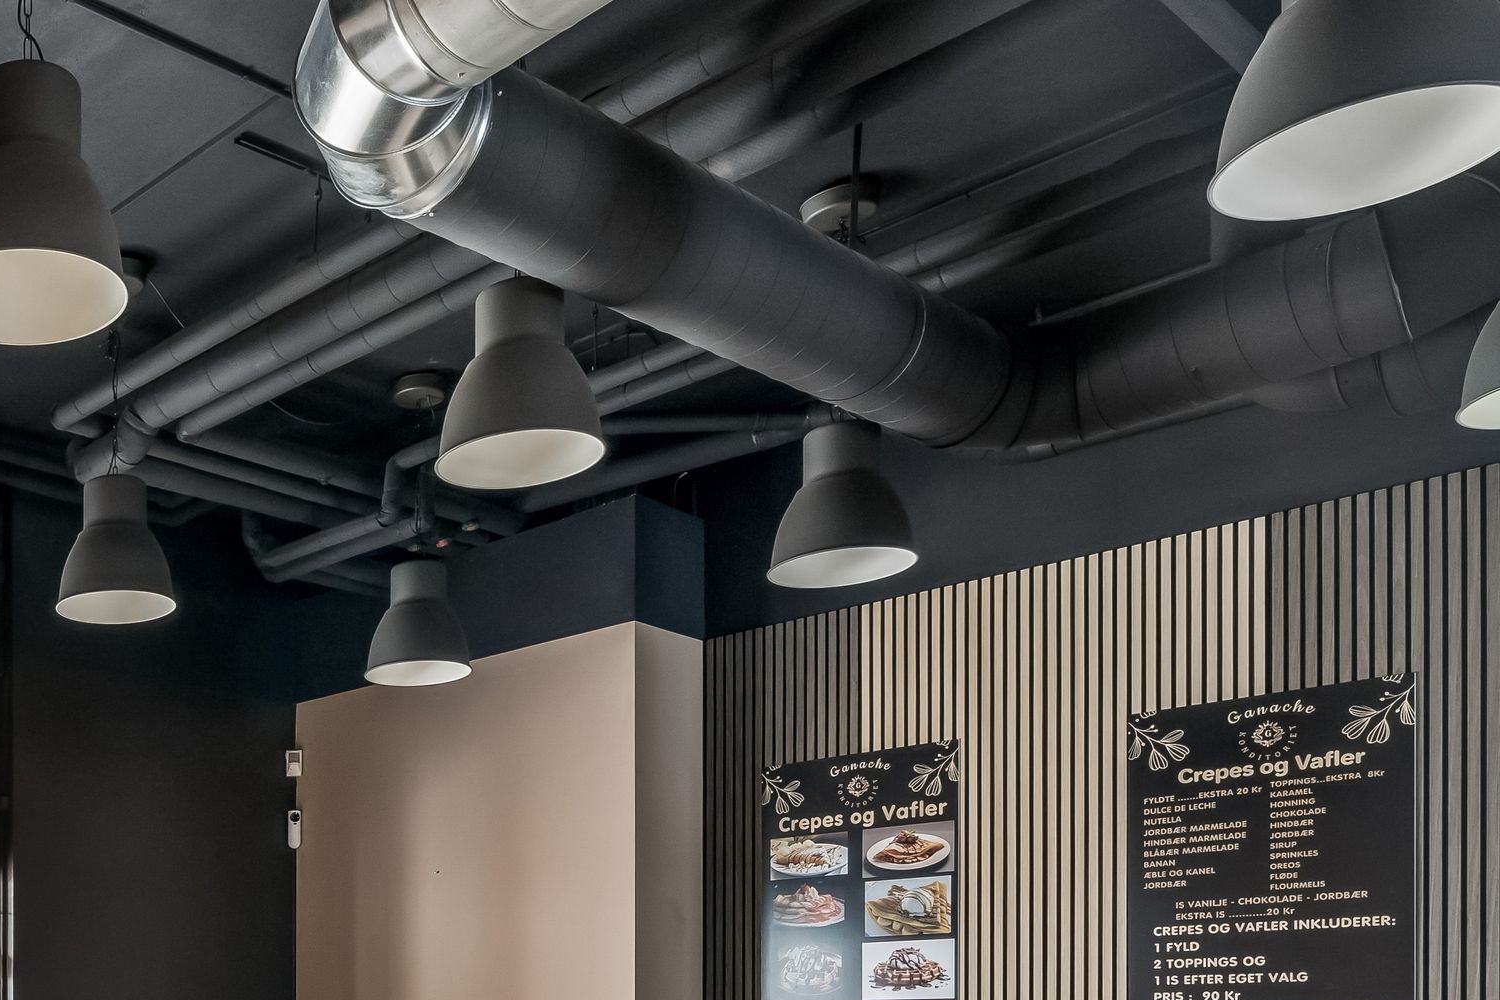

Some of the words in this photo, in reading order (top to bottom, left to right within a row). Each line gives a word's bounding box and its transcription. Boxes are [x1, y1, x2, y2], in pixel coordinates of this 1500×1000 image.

[1228, 699, 1316, 724] Ganache
[1238, 725, 1298, 760] KONDITORIET
[830, 758, 891, 777] Ganache
[1178, 764, 1255, 784] Crepes
[1259, 760, 1289, 777] og
[1295, 750, 1366, 771] Vafler
[1143, 795, 1175, 805] FYLDTE
[1236, 787, 1249, 795] 20
[1270, 788, 1313, 798] KARAMEL
[1143, 806, 1172, 815] DULCE
[1174, 805, 1186, 813] DE
[1189, 802, 1217, 811] LECHE
[1270, 798, 1316, 809] HONNING
[779, 813, 844, 833] Crepes
[850, 810, 875, 827] og
[881, 800, 948, 821] Vafler
[1270, 807, 1327, 819] CHOKOLADE
[1143, 816, 1182, 826] NUTELLA
[1270, 819, 1314, 829] HINDBÆR
[1143, 827, 1187, 837] JORDBÆR
[1189, 821, 1248, 832] MARMELADE
[1270, 830, 1315, 840] JORDBÆR
[1143, 837, 1187, 847] HINDBÆR
[1189, 832, 1247, 843] MARMELADE
[1270, 841, 1297, 850] SIRUP
[1143, 848, 1180, 858] BLÅBÆR
[1182, 843, 1240, 855] MARMELADE
[1270, 850, 1319, 860] SPRINKLES
[1143, 860, 1176, 868] BANAN
[1270, 862, 1301, 870] OREOS
[1144, 871, 1167, 879] ÆBLE
[1186, 867, 1216, 876] KANEL
[1270, 872, 1298, 880] FLØDE
[1143, 880, 1187, 890] JORDBÆR
[1270, 881, 1326, 891] FLOURMELIS
[1176, 901, 1185, 909] IS
[1188, 899, 1228, 908] VANILJE
[1238, 895, 1303, 905] CHOKOLADE
[1314, 890, 1368, 901] JORDBÆR
[1176, 911, 1213, 921] EKSTRA
[1216, 911, 1226, 919] IS
[1283, 907, 1295, 915] Kr
[1153, 925, 1204, 937] CREPES
[1208, 923, 1231, 934] OG
[1235, 920, 1289, 932] VAFLER
[1294, 915, 1396, 930] INKLUDERER:
[1154, 943, 1160, 953] 1
[1166, 942, 1200, 952] FYLD
[1153, 959, 1162, 969] 2
[1166, 957, 1238, 969] TOPPINGS
[1243, 956, 1266, 967] OG
[1154, 976, 1160, 986] 1
[1166, 975, 1179, 986] IS
[1184, 974, 1224, 985] EFTER
[1228, 973, 1264, 984] EGET
[1268, 972, 1309, 983] VALG
[1202, 991, 1220, 1000] 90
[1224, 991, 1241, 1000] Kr
